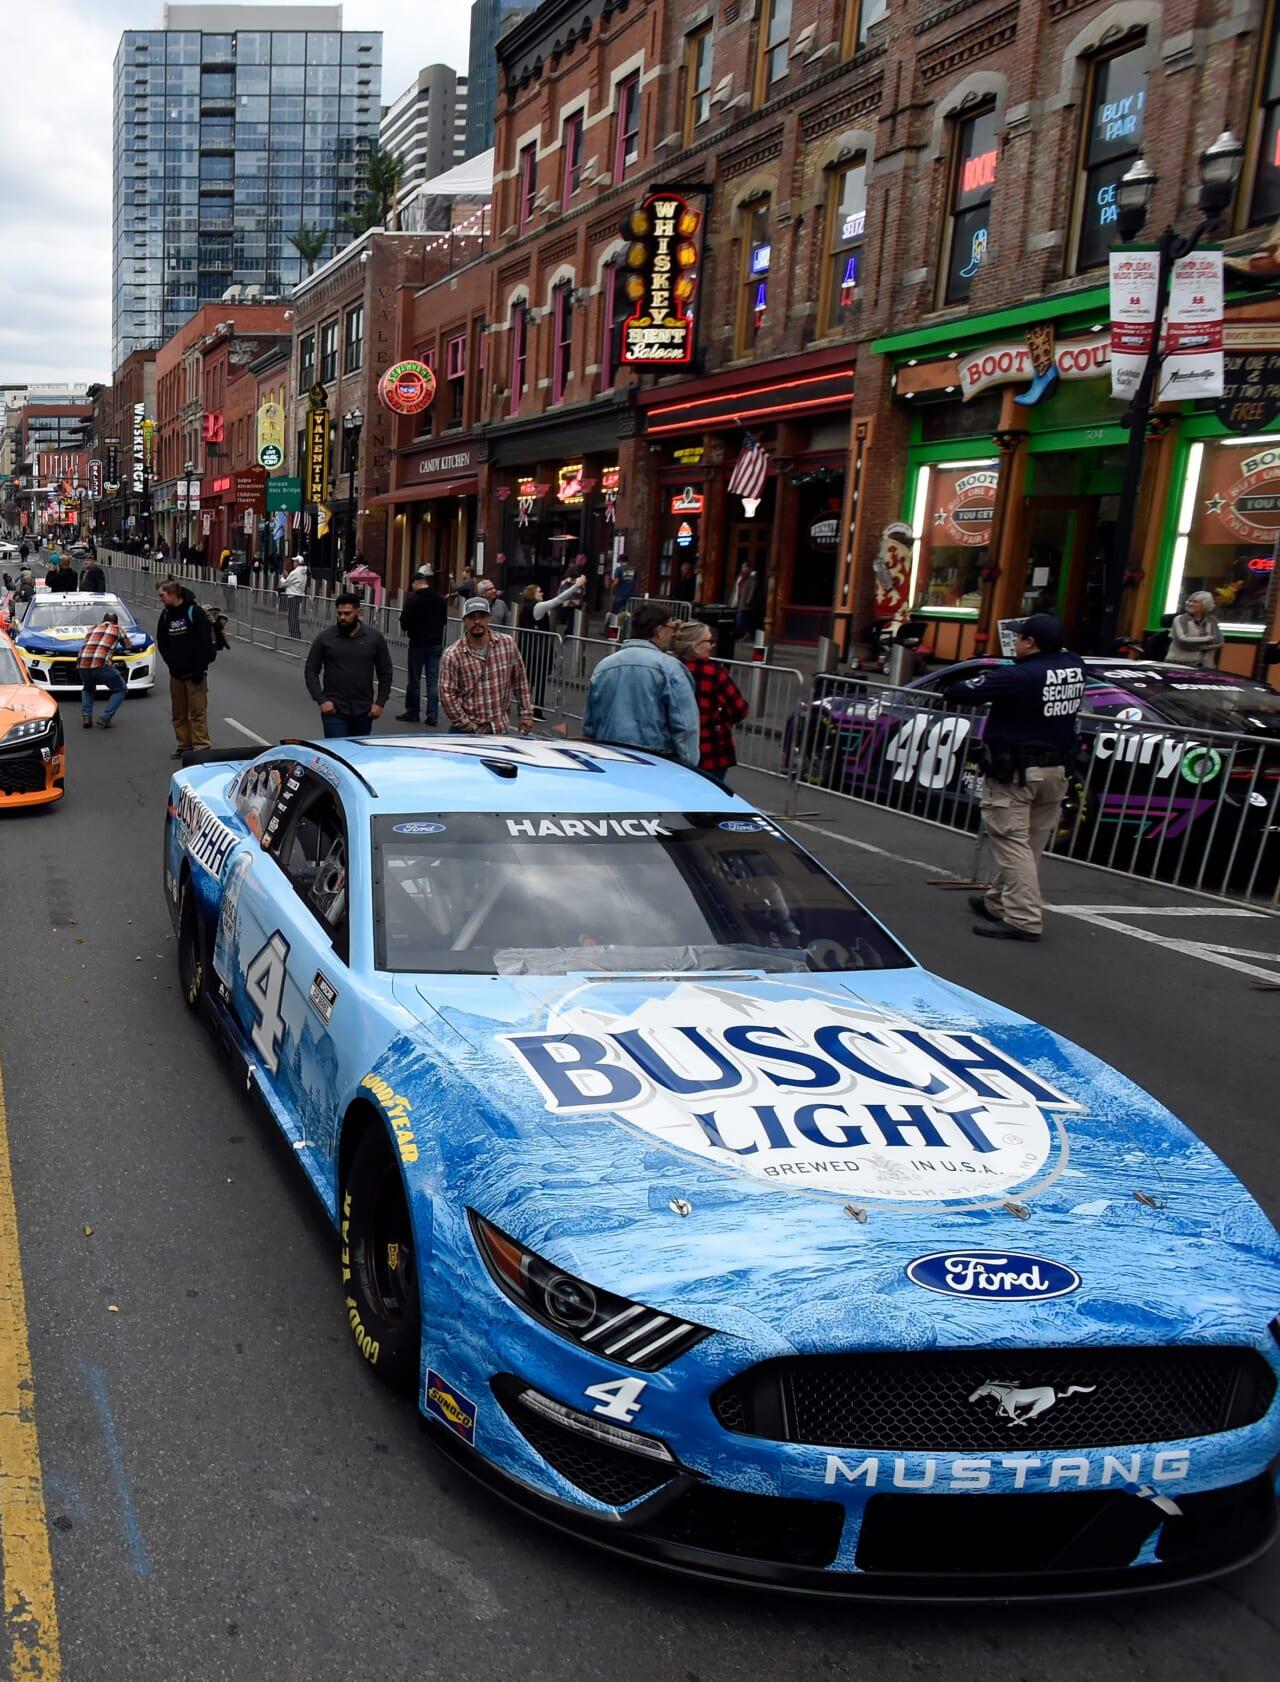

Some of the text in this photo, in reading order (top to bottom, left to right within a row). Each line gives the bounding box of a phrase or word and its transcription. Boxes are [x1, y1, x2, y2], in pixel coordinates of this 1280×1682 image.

[1102, 96, 1133, 122] BUY
[1106, 116, 1136, 142] PAIR
[1097, 184, 1118, 205] GE
[1100, 207, 1120, 225] PA
[648, 201, 678, 325] WHISKEY
[627, 328, 686, 343] BENT
[625, 342, 685, 360] Saloon
[967, 344, 1111, 385] BOOT COU
[1230, 401, 1266, 420] FREE
[133, 402, 145, 460] WHISKEY
[312, 415, 325, 502] VALENTINE
[419, 452, 470, 474] CANDY KITCHEN
[1244, 452, 1280, 473] BO
[957, 473, 998, 491] BOOT
[959, 511, 975, 520] YOU
[1045, 667, 1083, 685] APEX
[1042, 683, 1086, 702] SECURITY
[1044, 699, 1081, 717] GROUP
[886, 713, 971, 789] 48
[505, 818, 673, 837] HARVICK
[246, 928, 291, 1078] 4
[513, 1025, 1074, 1109] BUSCH
[691, 1103, 1002, 1154] LIGHT
[763, 1158, 1004, 1177] BREWED IN U.S.A.
[945, 1256, 1049, 1292] Ford
[427, 1386, 473, 1429] SUNOCO
[583, 1375, 649, 1423] 4
[823, 1449, 1191, 1490] MUSTANG
